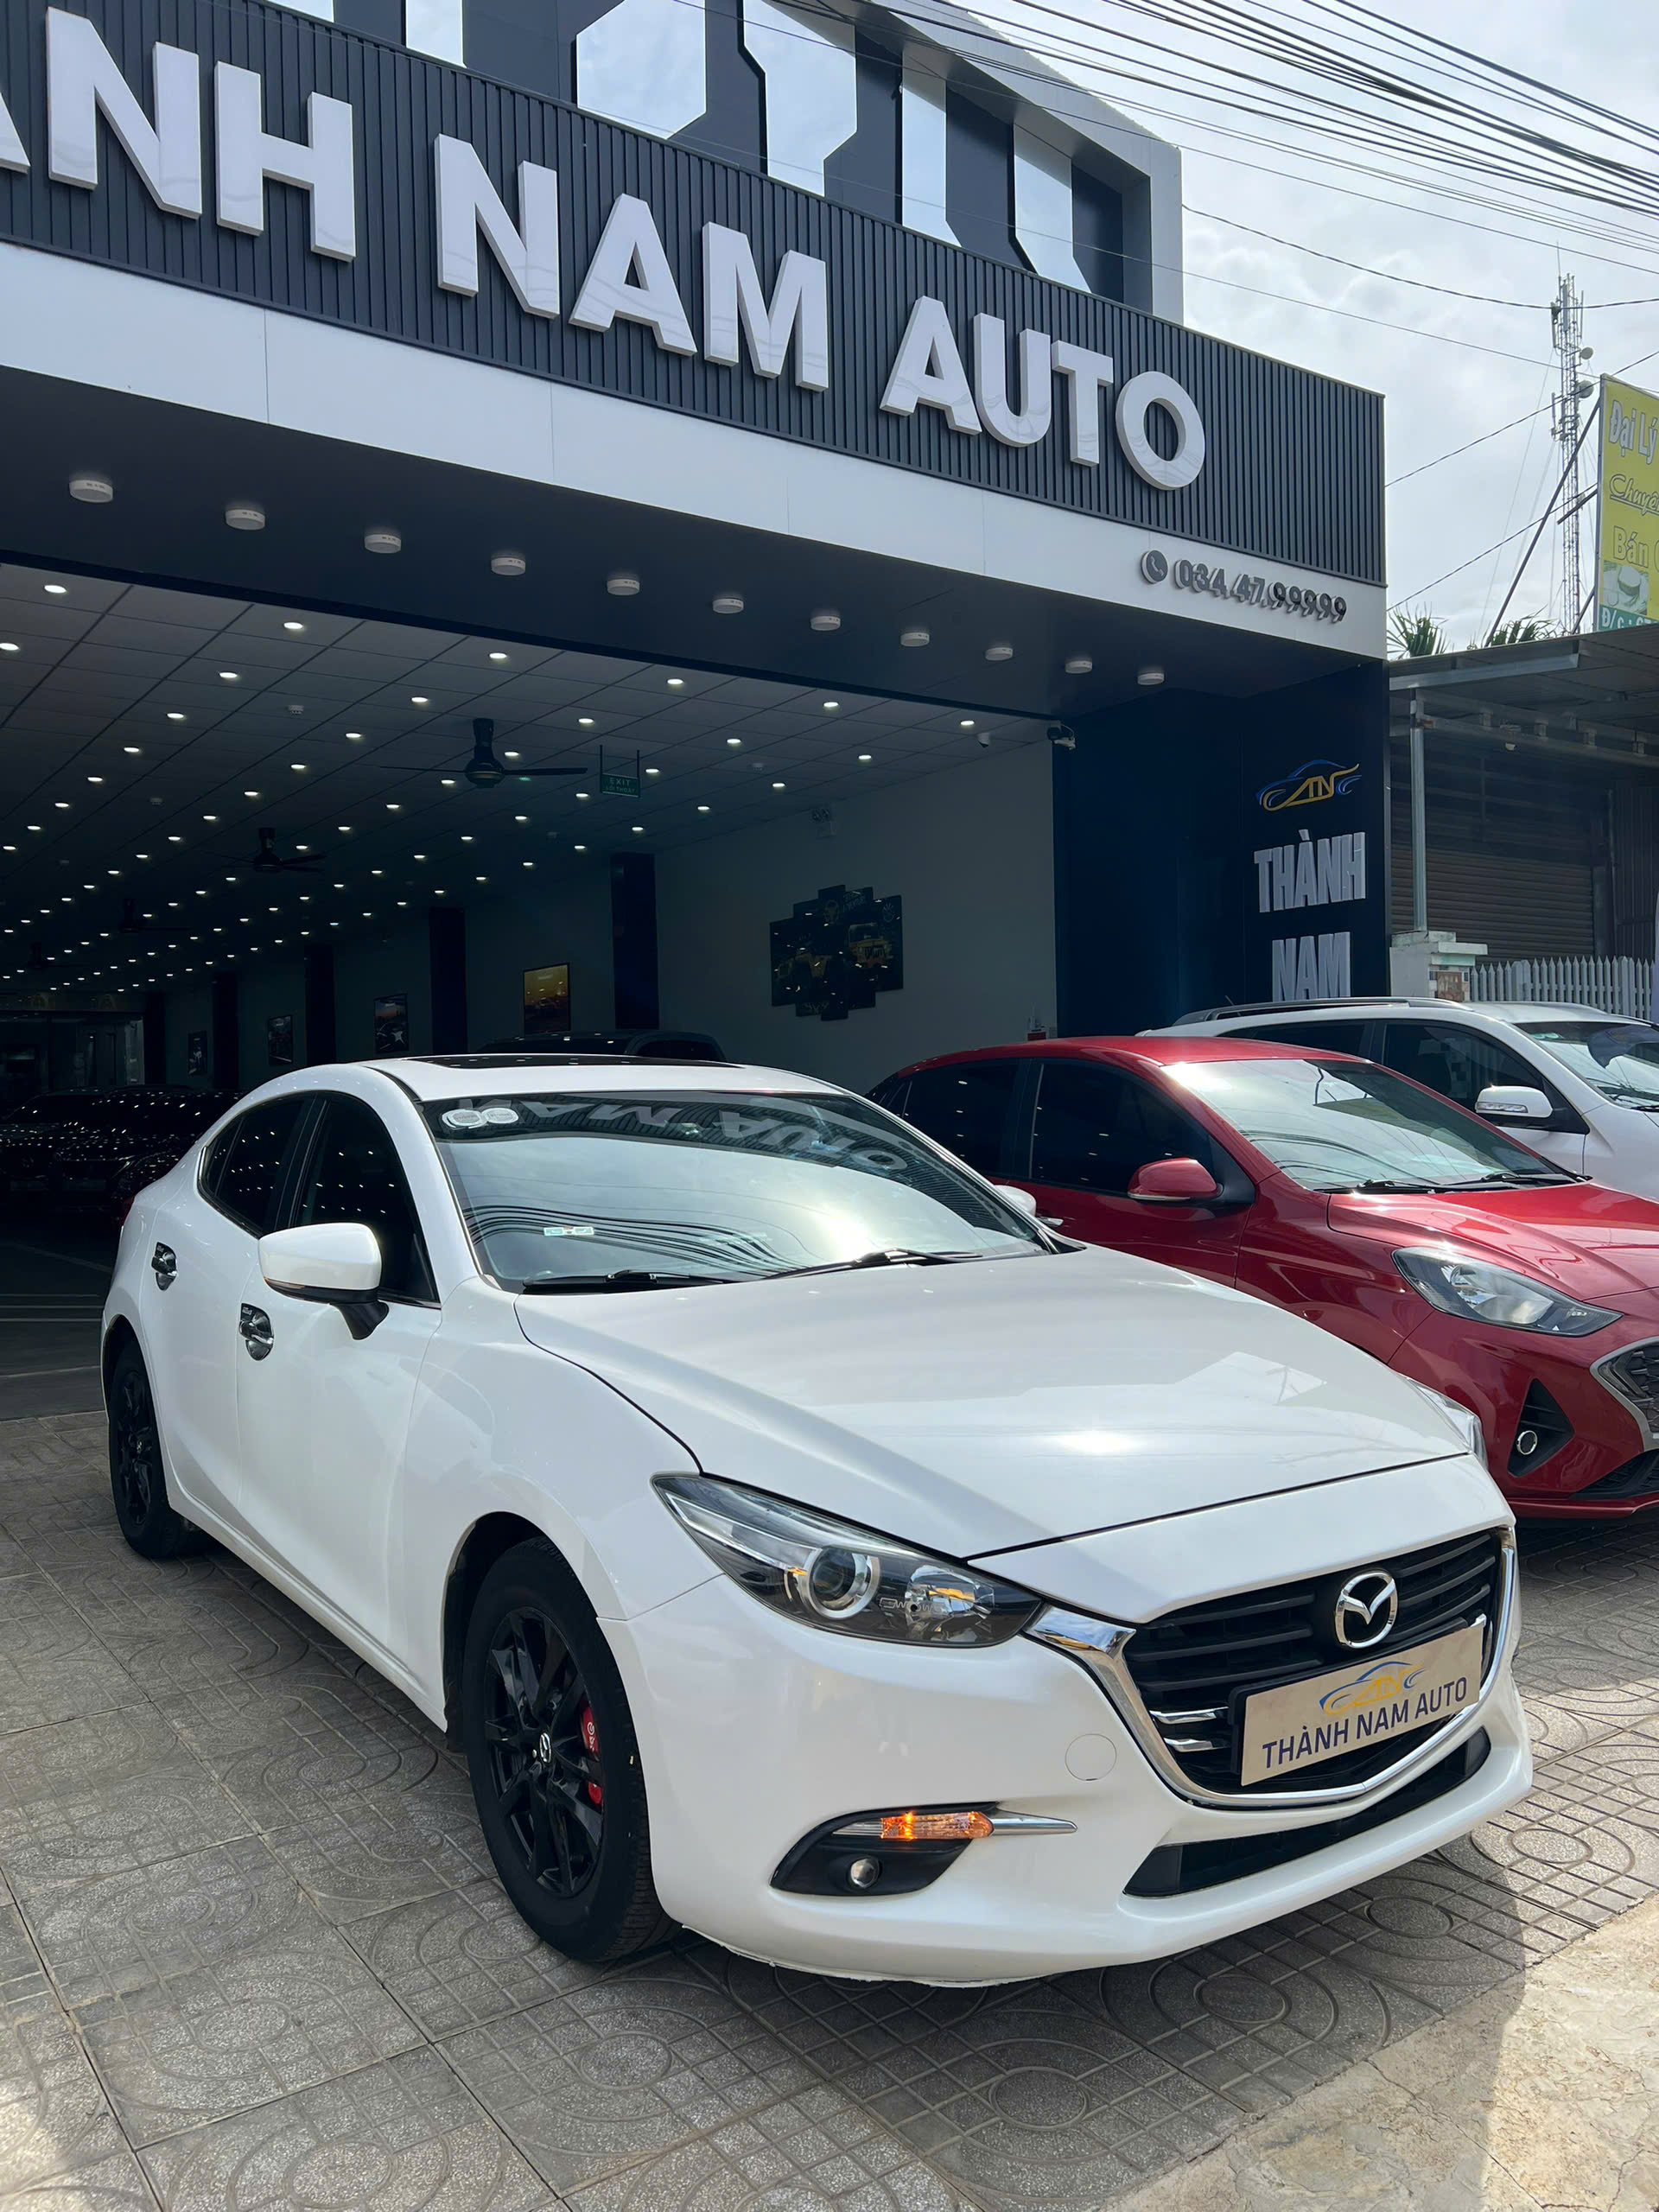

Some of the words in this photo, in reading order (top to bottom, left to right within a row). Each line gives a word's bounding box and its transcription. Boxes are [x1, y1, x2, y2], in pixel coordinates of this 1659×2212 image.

[0, 6, 357, 264] NH
[434, 133, 830, 393] NAM
[879, 295, 1206, 492] AUTO
[1609, 398, 1637, 458] Đại
[1638, 410, 1658, 465] Lý
[1612, 524, 1649, 569] Bán
[1174, 559, 1347, 623] 034.47.99999
[608, 777, 631, 786] EXIT
[1253, 828, 1367, 914] THÀNH
[1271, 931, 1351, 1003] NAM
[1262, 1718, 1350, 1769] THÀNH
[1356, 1699, 1409, 1740] NAM
[1414, 1676, 1467, 1719] AUTO
